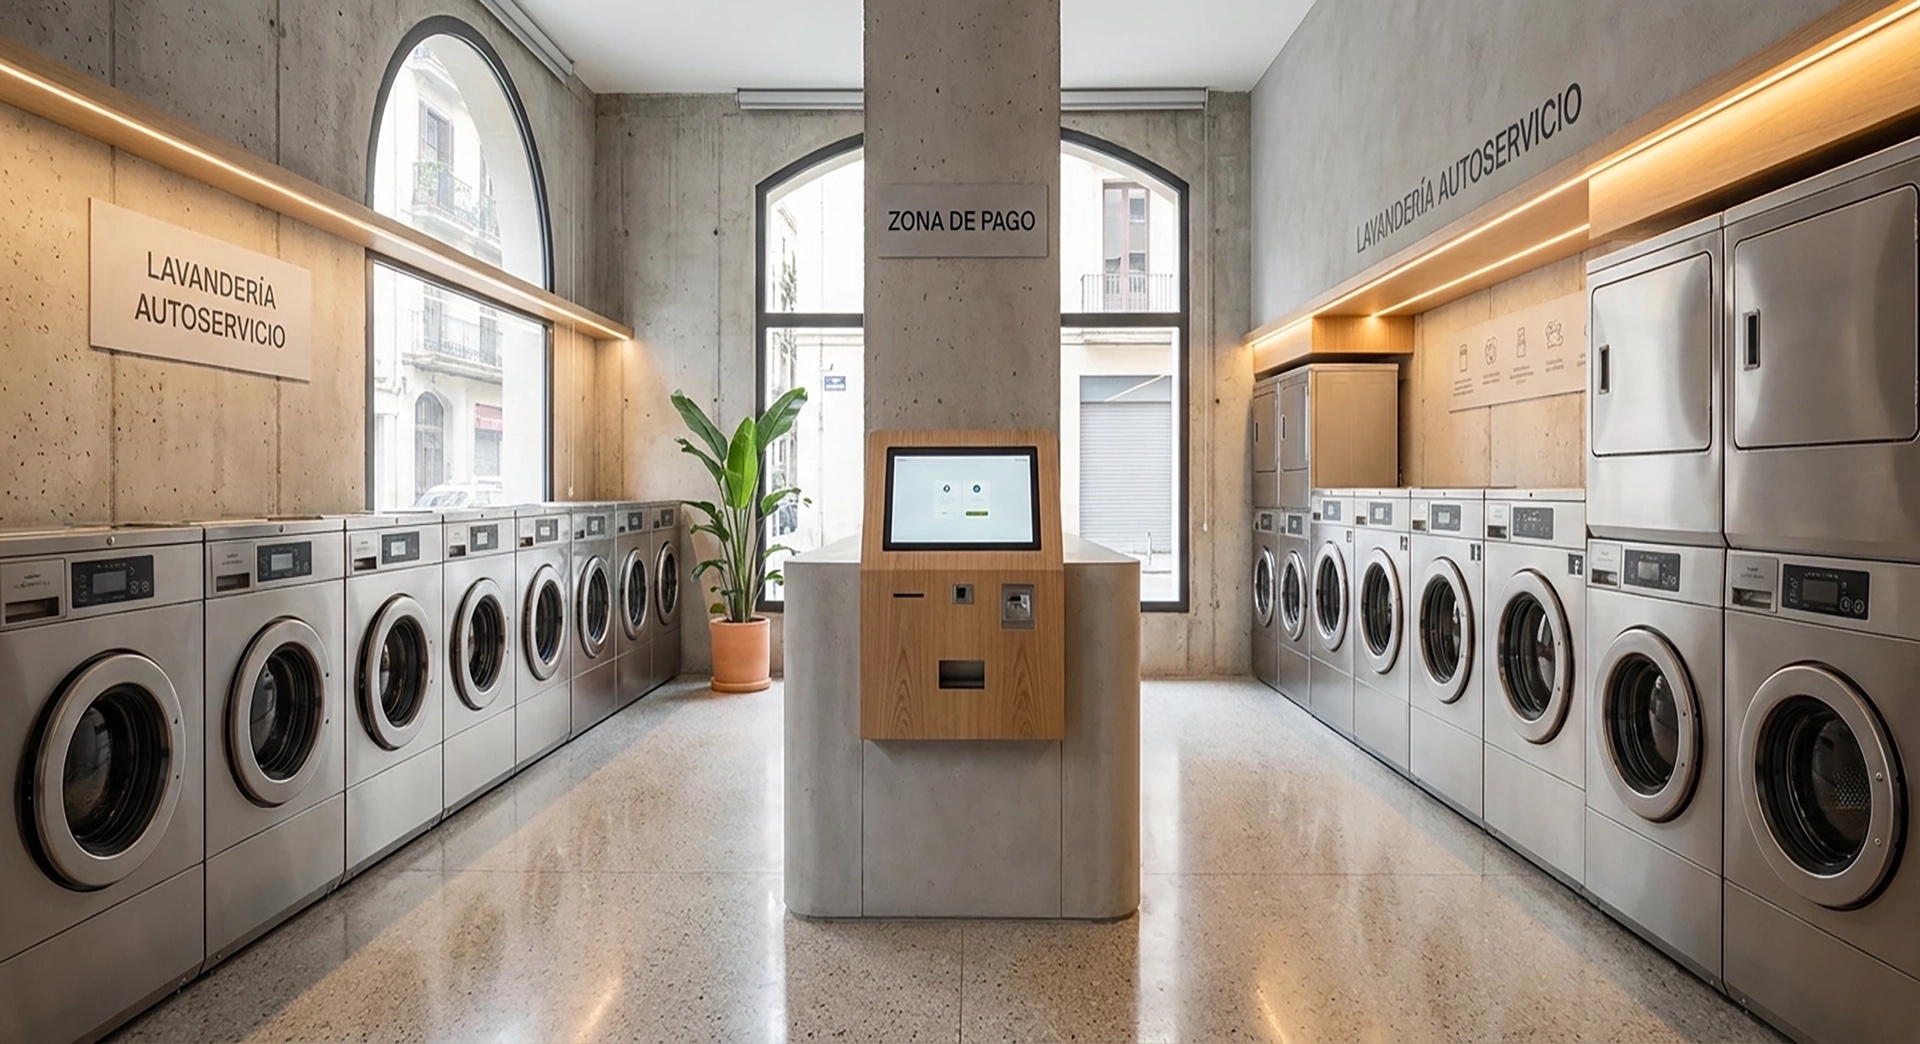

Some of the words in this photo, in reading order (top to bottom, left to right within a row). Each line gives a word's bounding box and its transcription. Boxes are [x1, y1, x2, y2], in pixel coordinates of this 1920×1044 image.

[1356, 176, 1434, 254] LAVANDERÍA
[1438, 82, 1582, 206] AUTOSERVICIO
[888, 210, 944, 231] ZONA
[950, 210, 976, 231] DE
[981, 210, 1036, 231] PAGO
[134, 293, 286, 349] AUTOSERVICIO
